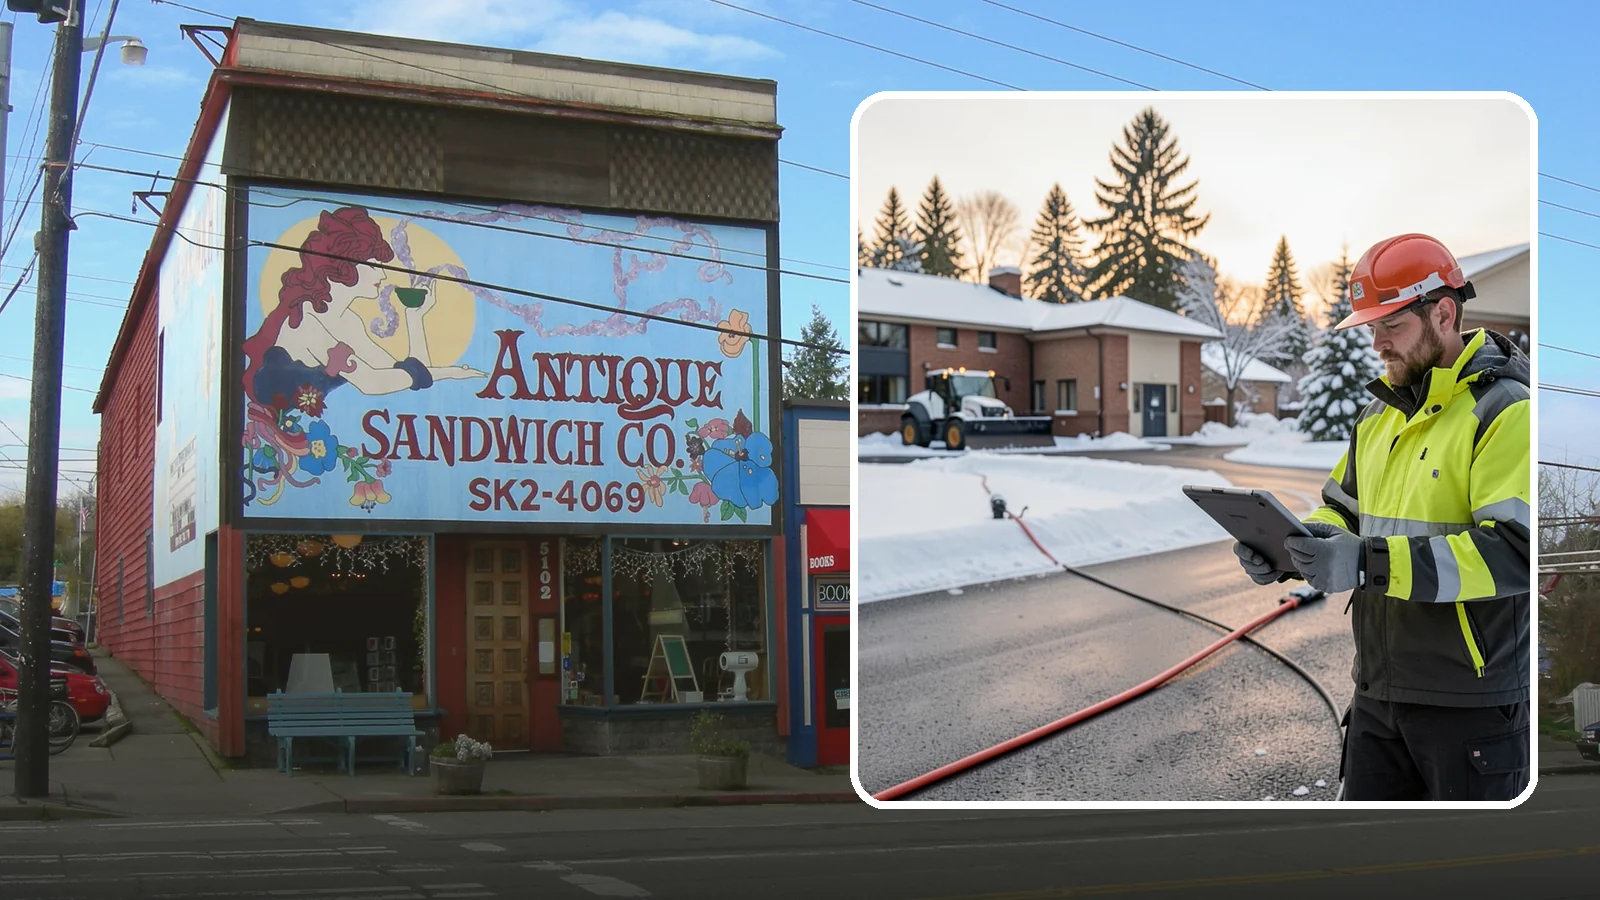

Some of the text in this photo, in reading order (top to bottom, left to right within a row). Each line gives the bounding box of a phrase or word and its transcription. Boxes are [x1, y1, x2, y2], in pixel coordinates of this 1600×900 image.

[476, 329, 723, 420] ANTIQUE
[361, 409, 685, 469] SANDWICH CO.
[468, 477, 646, 512] SK2-4069
[539, 542, 551, 599] 5102
[809, 555, 835, 569] BOOKS
